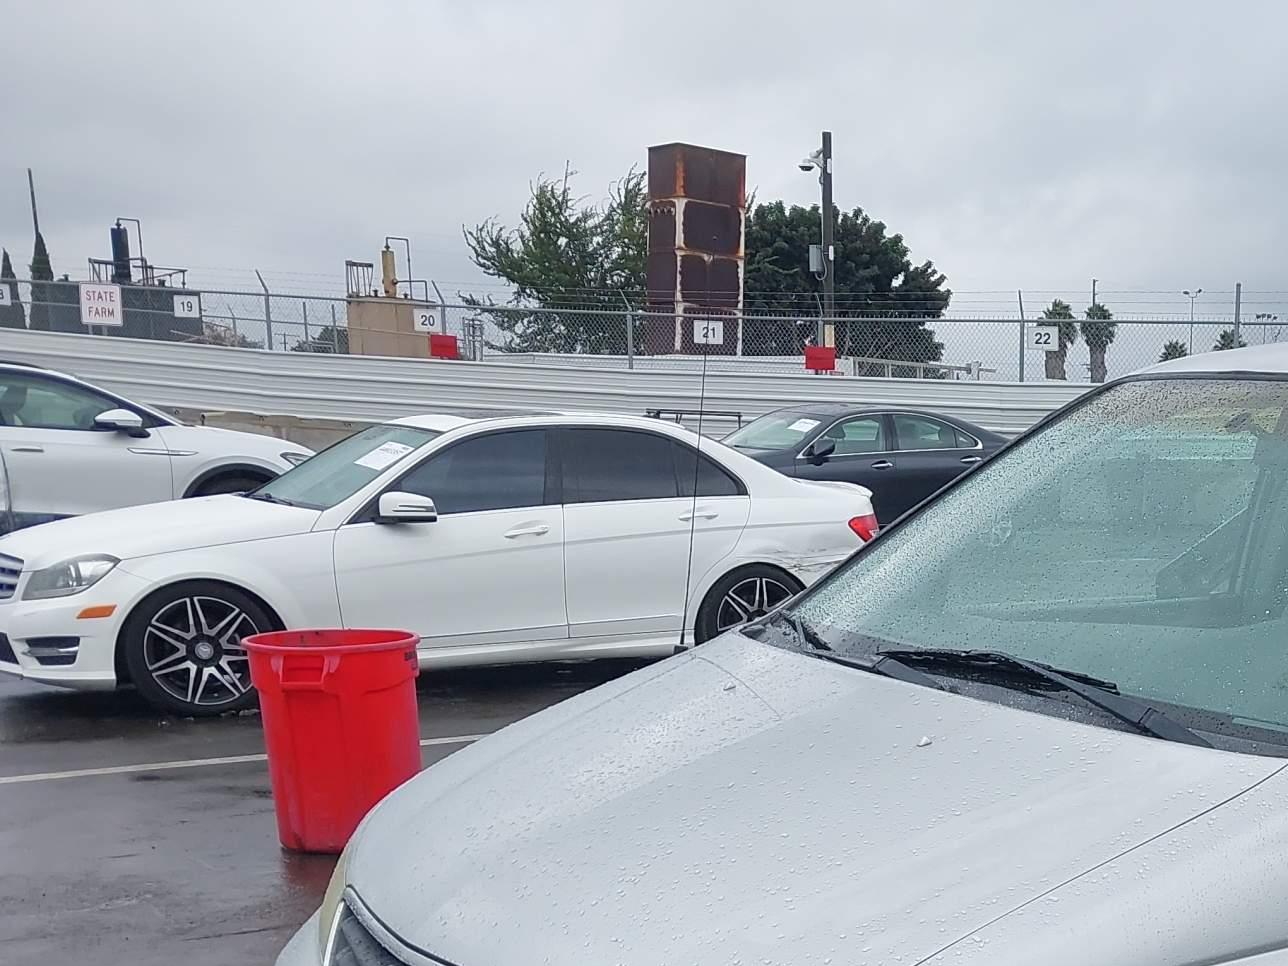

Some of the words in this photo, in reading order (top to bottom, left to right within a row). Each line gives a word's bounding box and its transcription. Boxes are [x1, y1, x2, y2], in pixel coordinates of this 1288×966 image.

[85, 290, 116, 302] STATE
[88, 306, 115, 318] FARM
[180, 300, 193, 312] 19
[420, 314, 435, 327] 20
[702, 326, 716, 338] 21
[1034, 332, 1051, 345] 22
